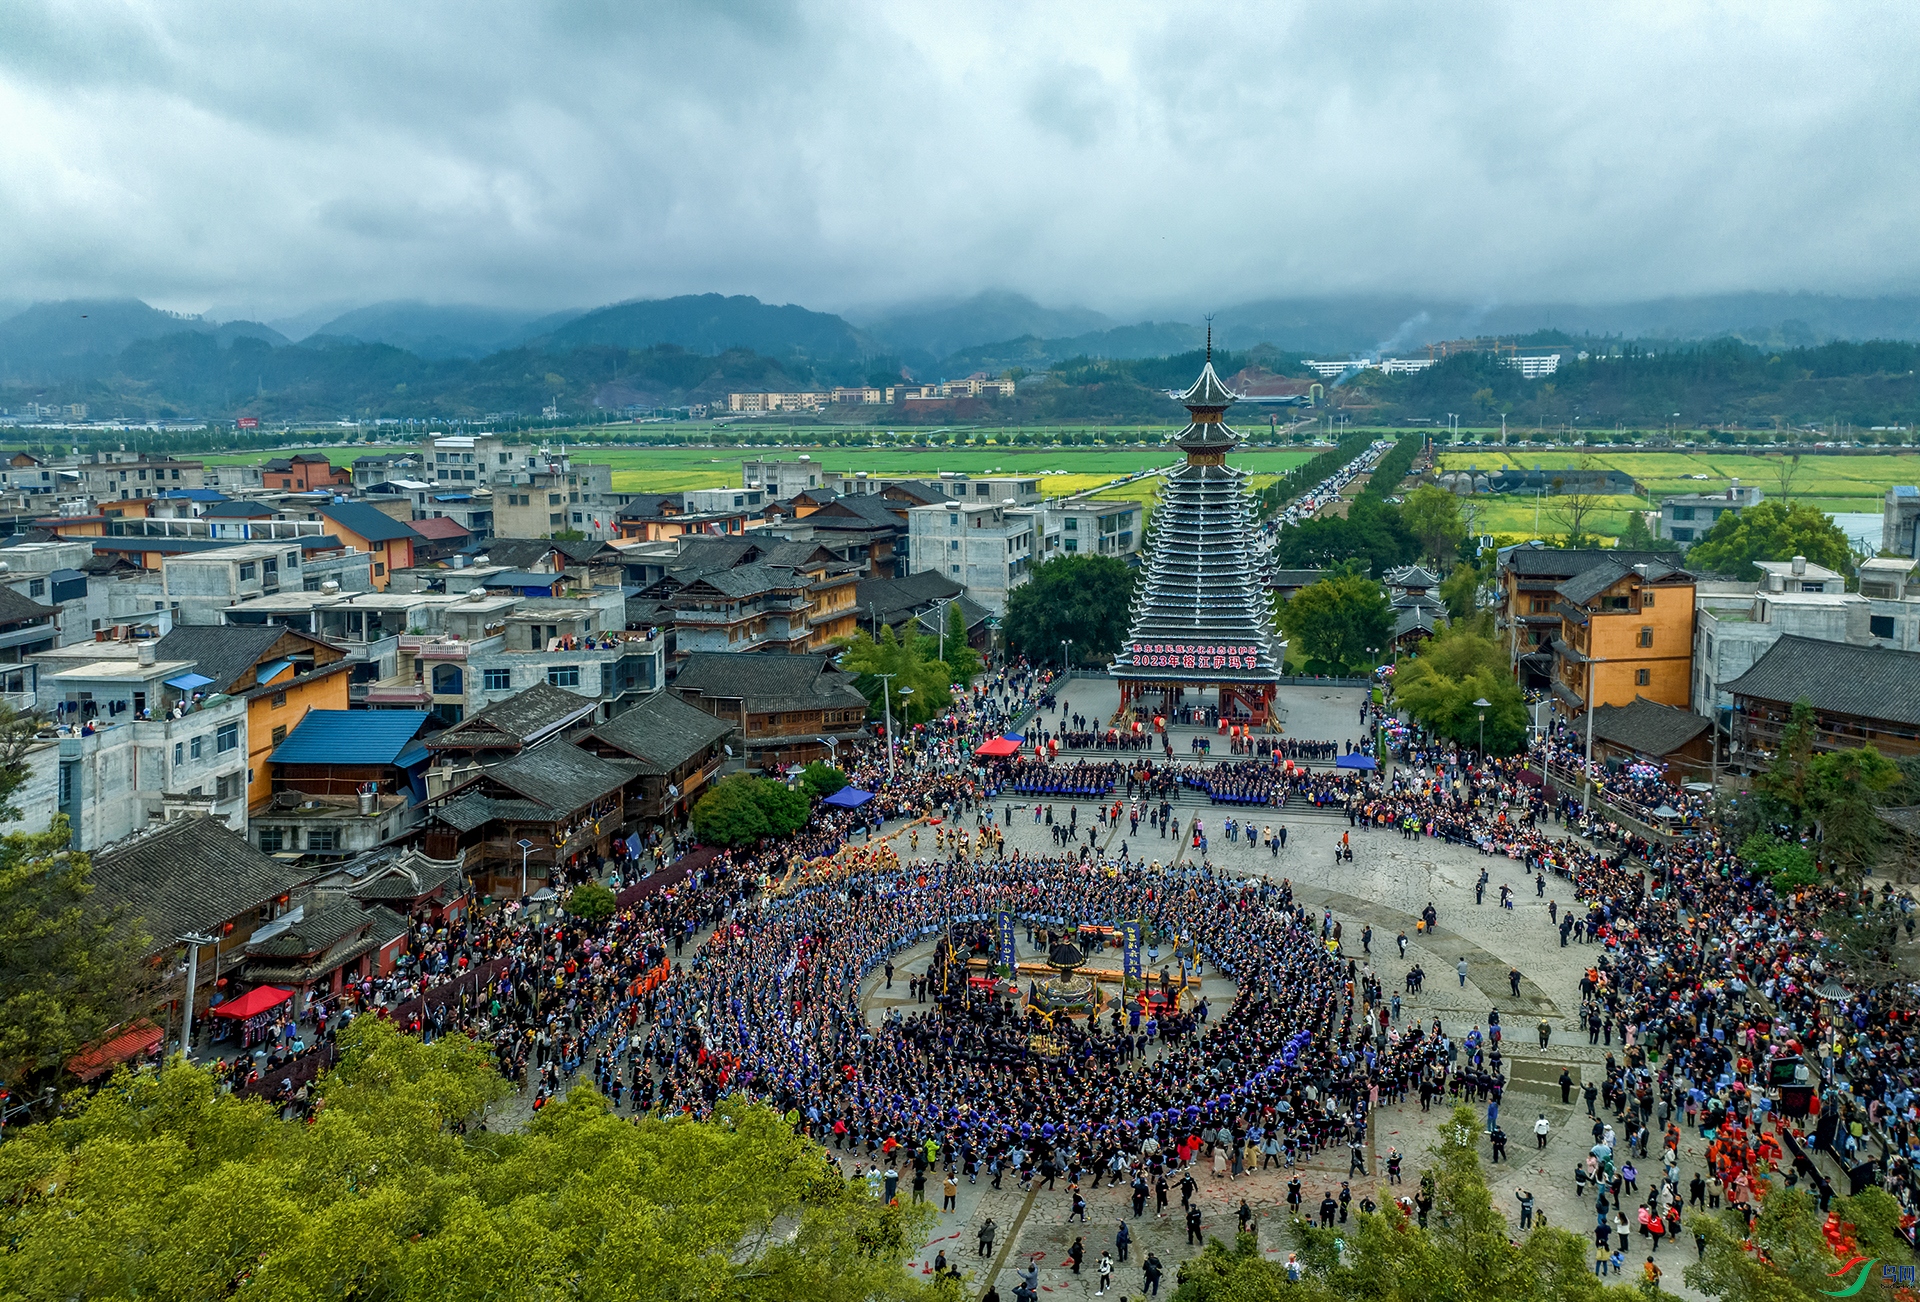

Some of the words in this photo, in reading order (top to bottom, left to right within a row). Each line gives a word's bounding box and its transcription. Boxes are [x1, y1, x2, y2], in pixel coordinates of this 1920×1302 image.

[1132, 644, 1257, 655] 黔东南民族文化生态保护区
[1132, 655, 1257, 669] 2023年榕江萨玛节
